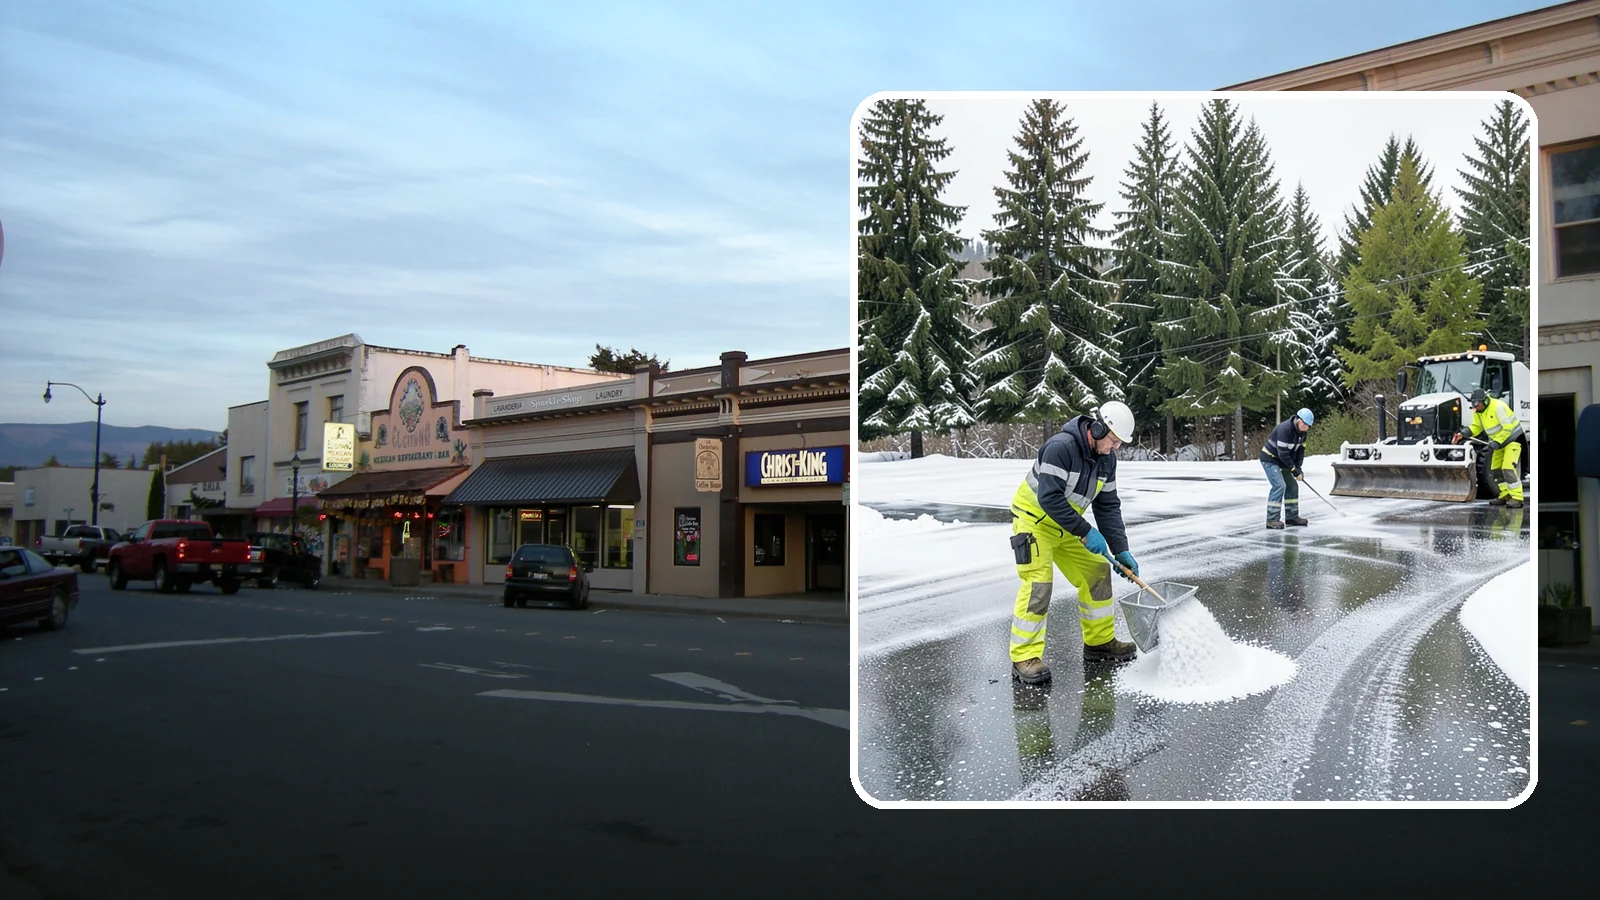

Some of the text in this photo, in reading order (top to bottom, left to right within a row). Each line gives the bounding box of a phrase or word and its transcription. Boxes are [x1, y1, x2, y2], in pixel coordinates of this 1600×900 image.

[493, 389, 624, 413] LAVANDERIA Sparkle Shop LAUNDRY
[373, 454, 396, 464] MEXICAN
[397, 451, 434, 462] RESTAURANT
[437, 450, 450, 459] BAR
[760, 450, 827, 478] CHRIST KING
